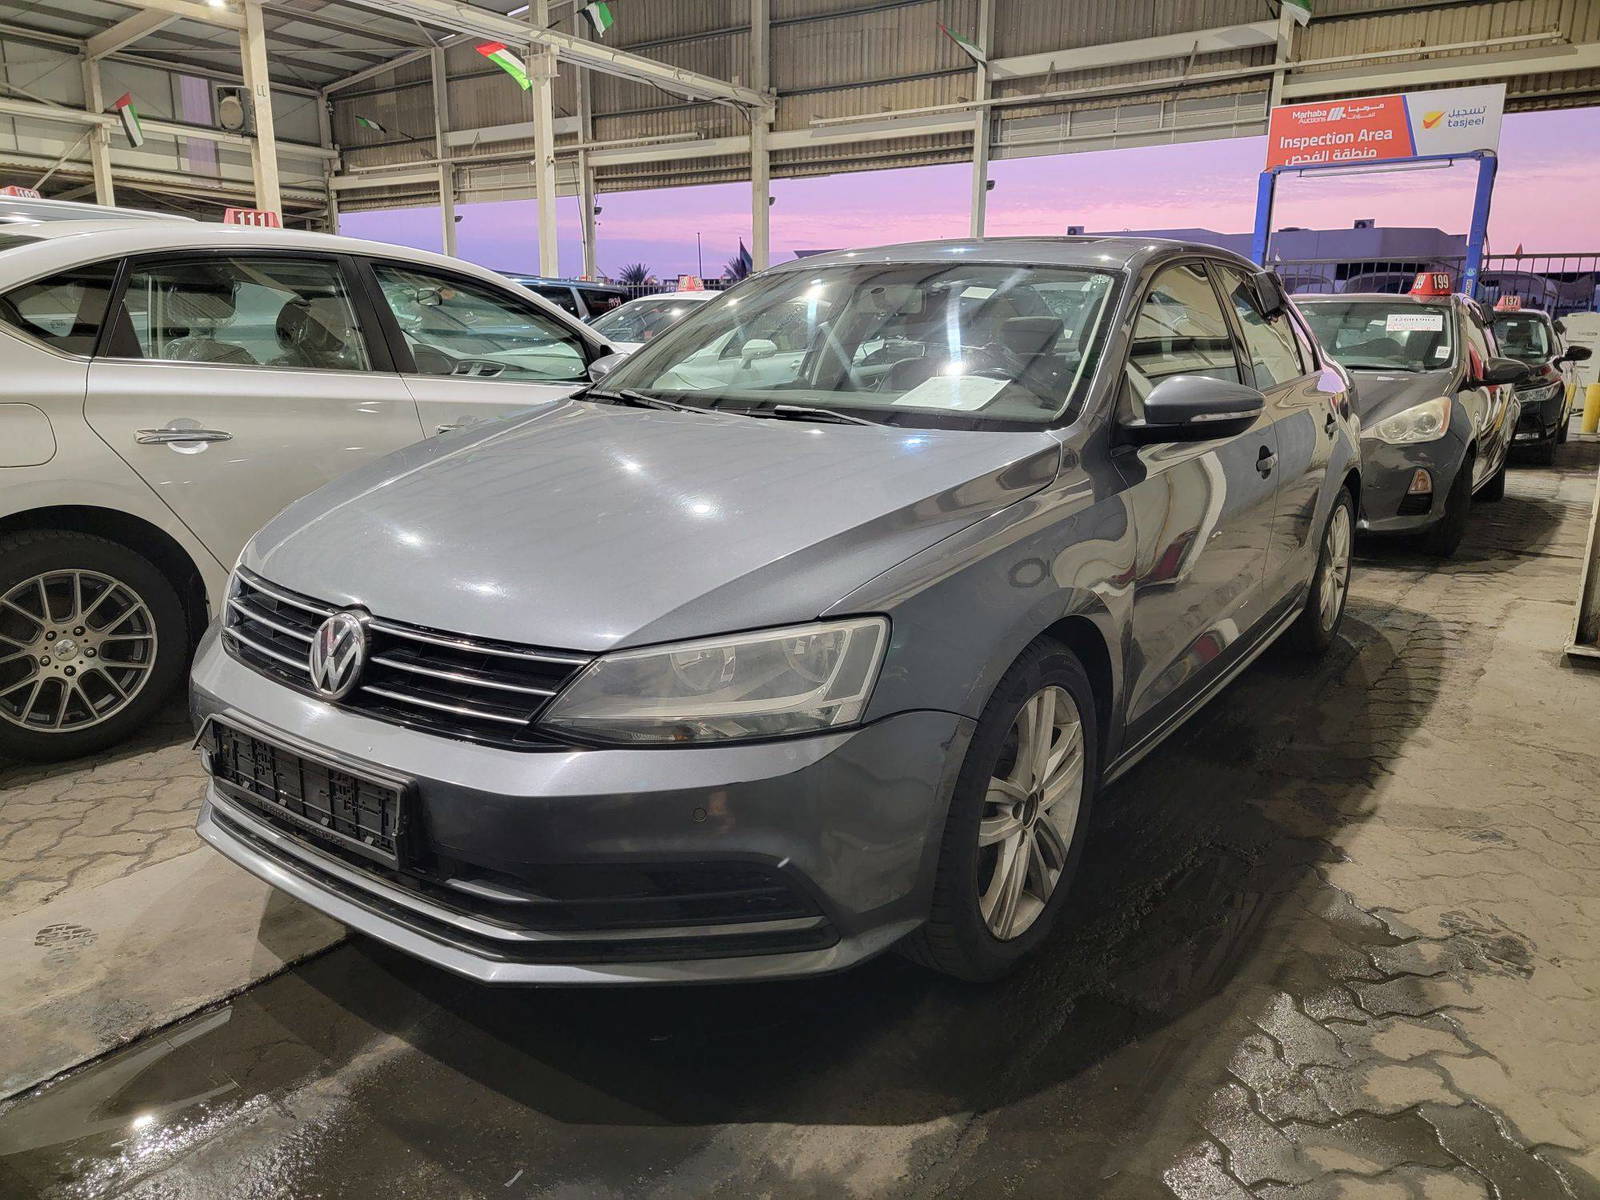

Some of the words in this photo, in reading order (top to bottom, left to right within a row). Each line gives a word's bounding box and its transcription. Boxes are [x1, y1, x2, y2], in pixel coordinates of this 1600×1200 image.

[1292, 110, 1327, 120] Marhaba
[1448, 105, 1487, 117] تسجيل
[1448, 117, 1485, 128] tasjeel
[1280, 132, 1354, 150] Inspection
[1358, 128, 1393, 142] Area
[1285, 151, 1329, 165] الفحص
[1333, 147, 1377, 160] منطقة
[237, 211, 265, 226] 111
[1433, 274, 1449, 289] 199
